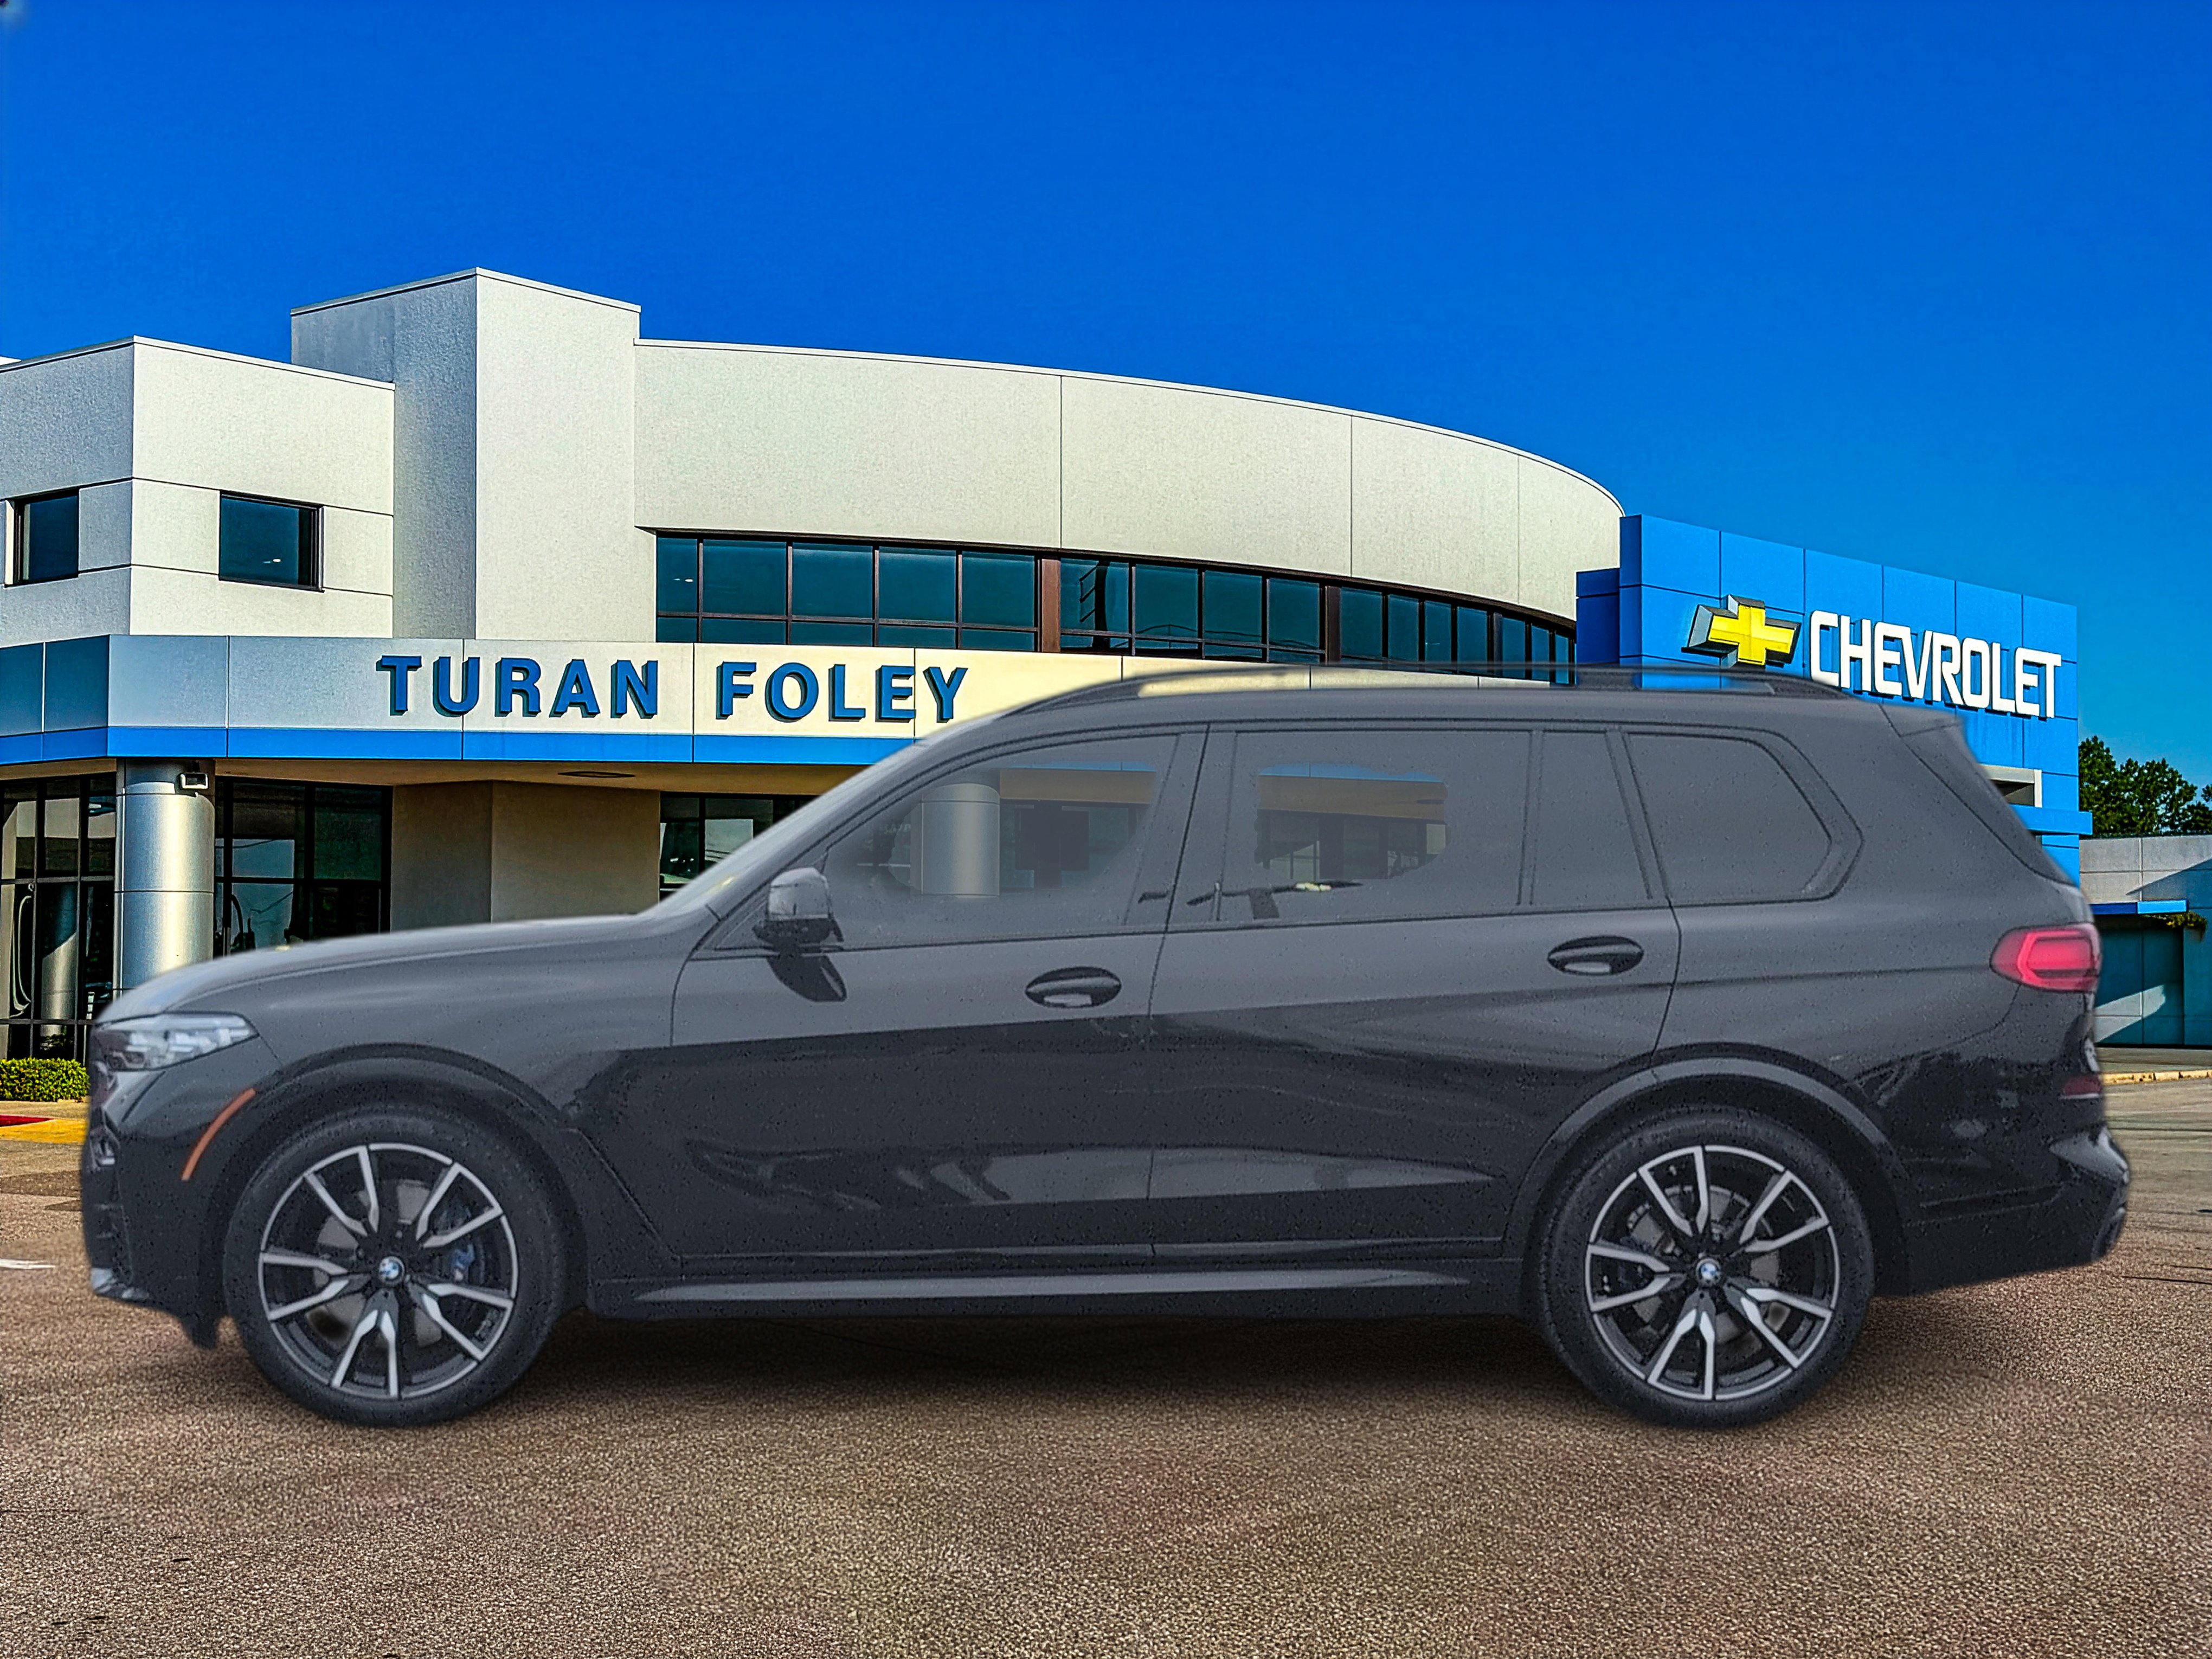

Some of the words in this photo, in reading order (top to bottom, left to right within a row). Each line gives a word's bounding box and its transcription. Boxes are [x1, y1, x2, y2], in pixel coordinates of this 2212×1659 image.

[376, 655, 658, 718] TURAN
[716, 662, 968, 722] FOLEY
[1810, 610, 2061, 718] CHEVROLET
